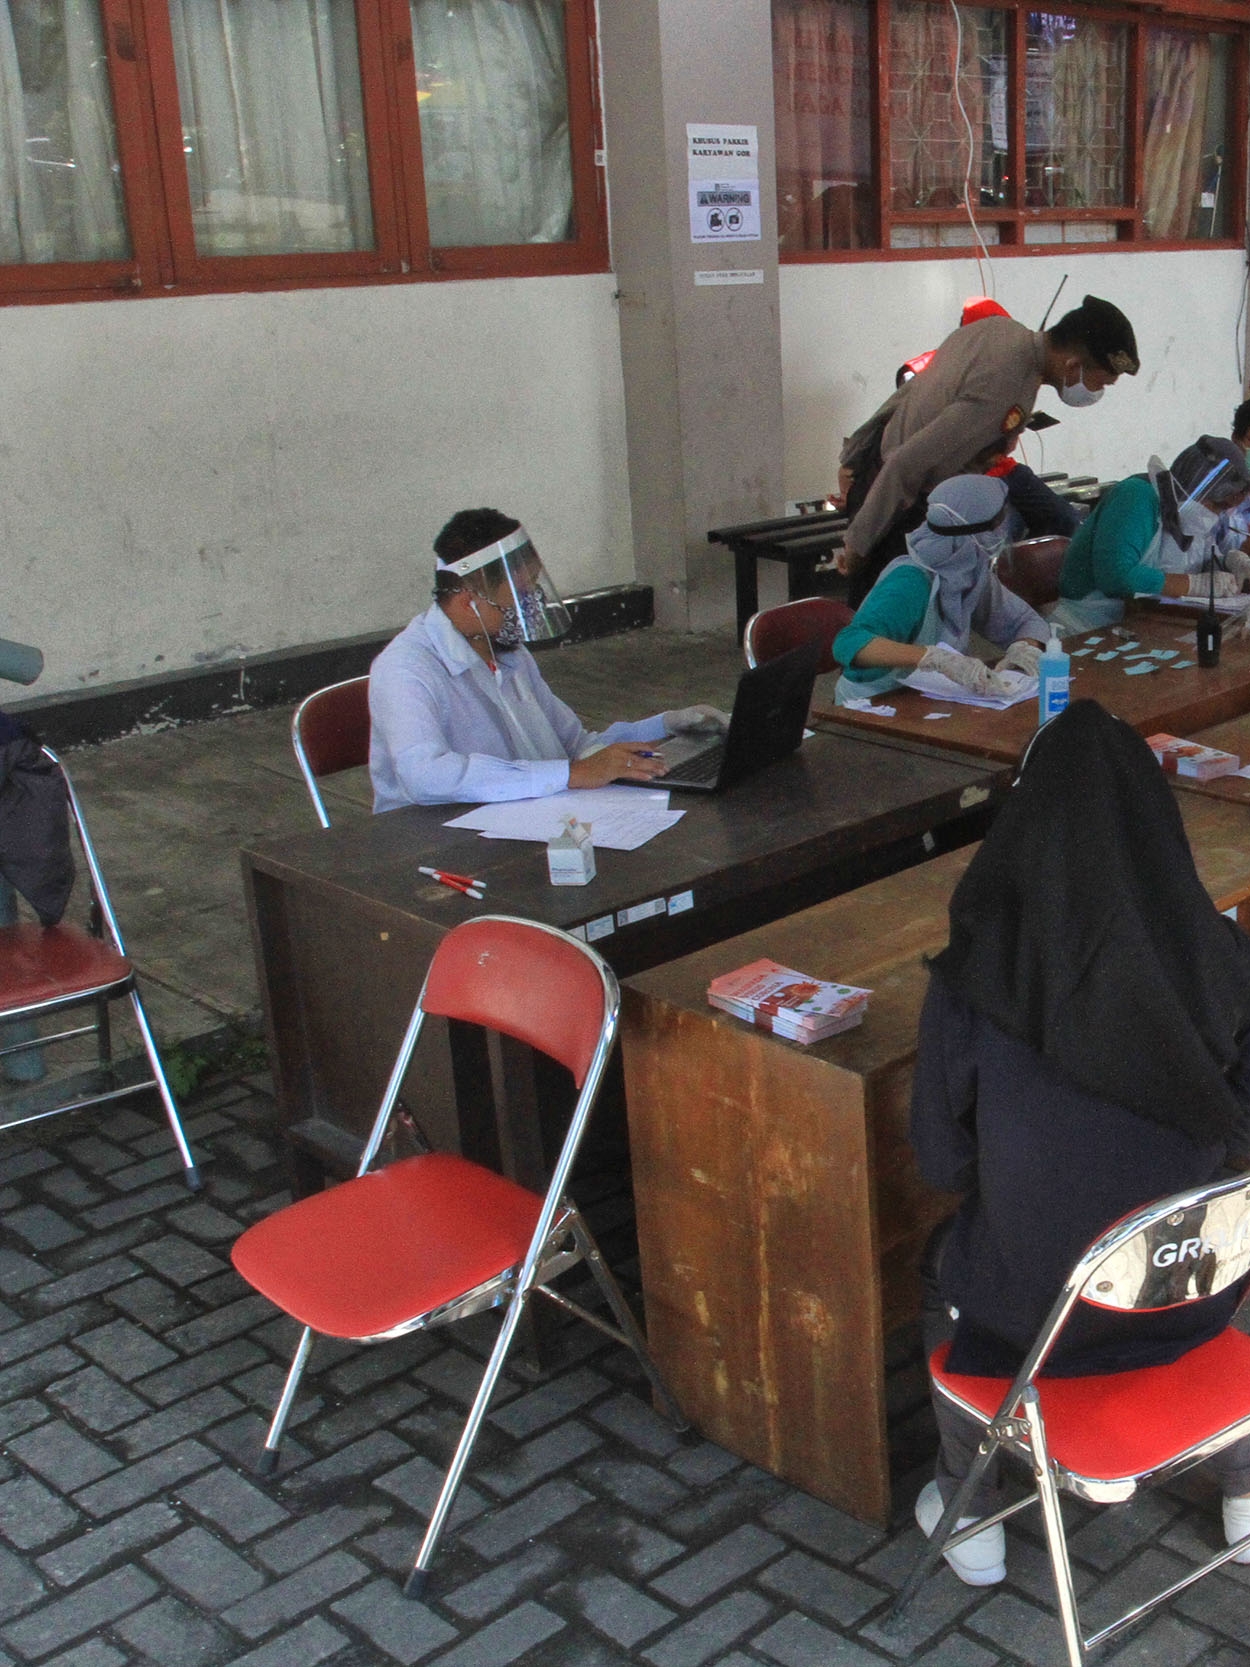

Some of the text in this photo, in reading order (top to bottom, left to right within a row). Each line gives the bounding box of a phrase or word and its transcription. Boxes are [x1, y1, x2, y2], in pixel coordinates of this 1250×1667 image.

[692, 137, 749, 146] KHUSUS PARKIR
[709, 193, 750, 204] WARNING
